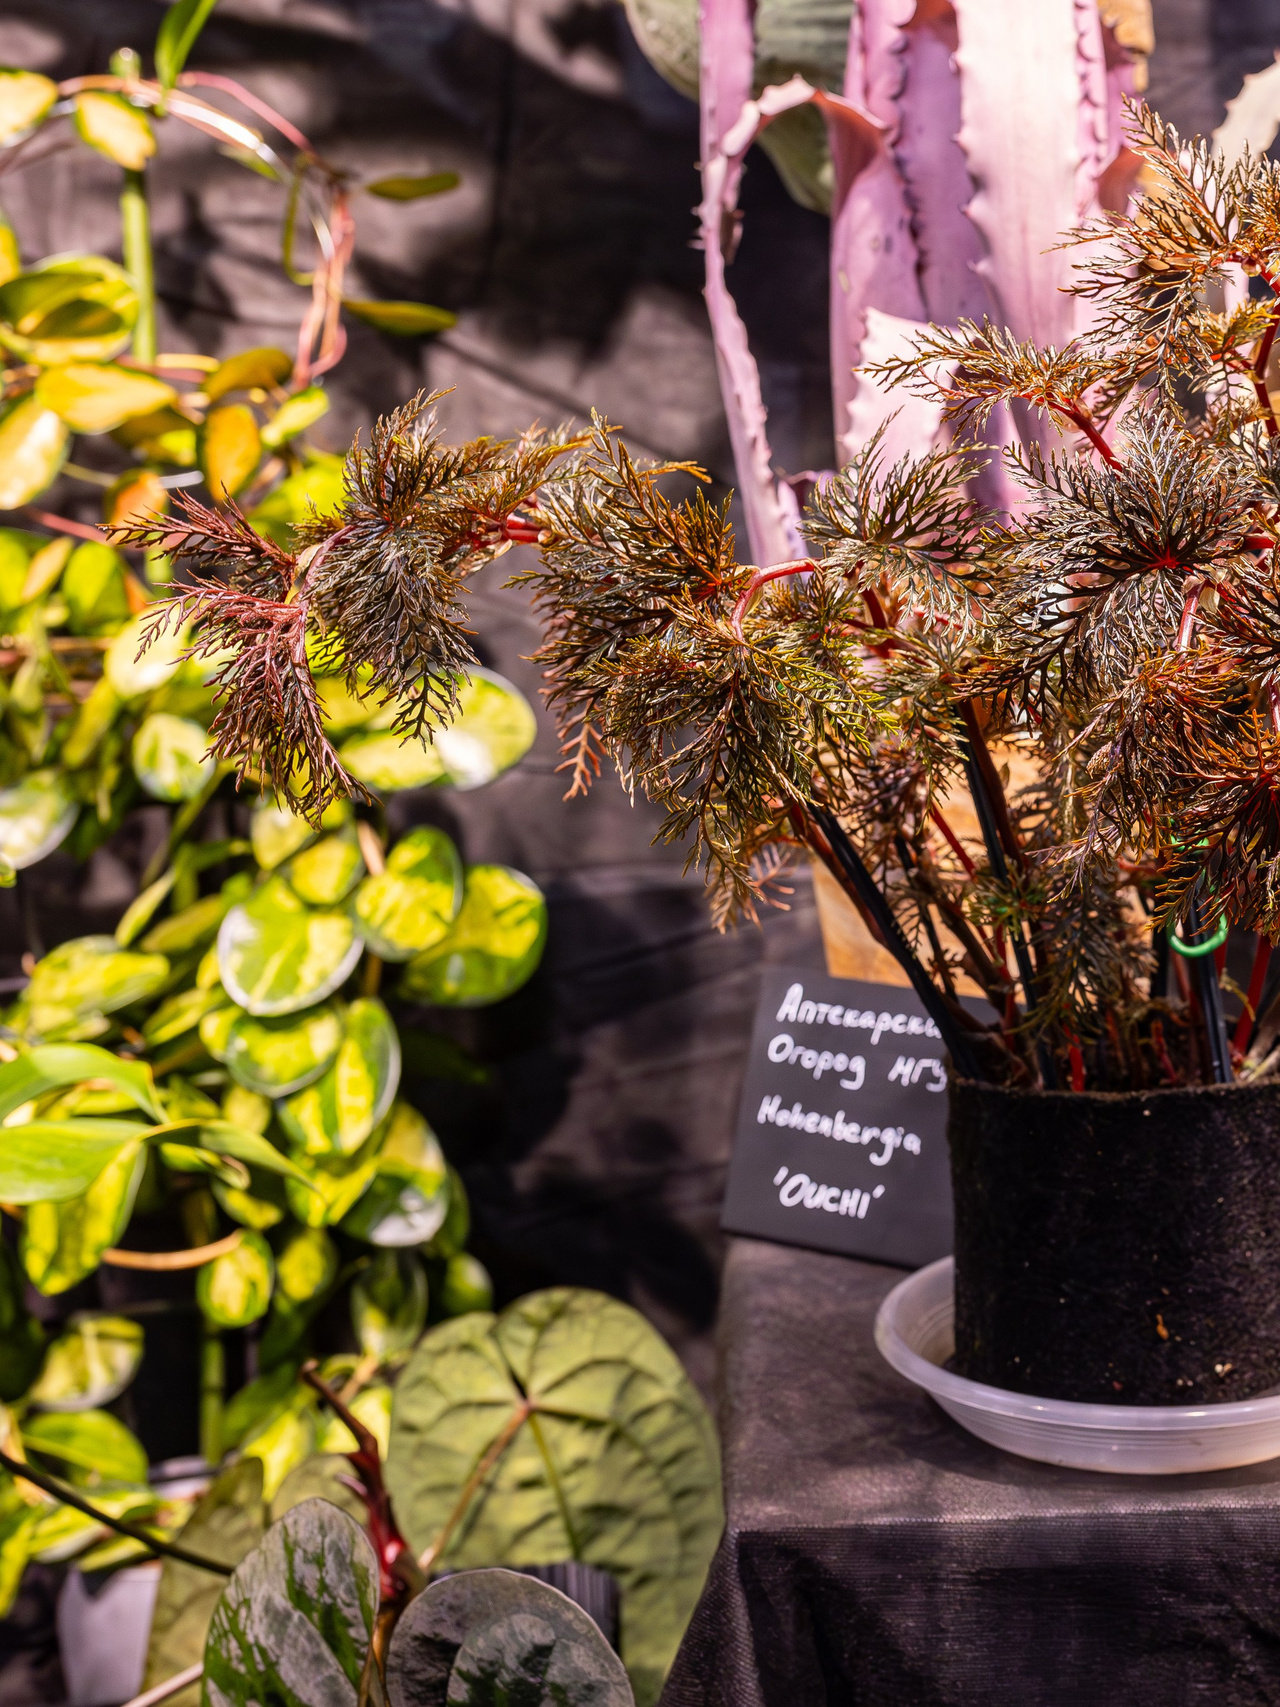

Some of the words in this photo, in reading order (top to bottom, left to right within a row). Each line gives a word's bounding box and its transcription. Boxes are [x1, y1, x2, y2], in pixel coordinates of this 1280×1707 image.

[776, 982, 942, 1046] Аптекарски
[767, 1033, 866, 1091] Огород
[887, 1055, 947, 1092] МГУ
[756, 1093, 922, 1167] Hohenbergia
